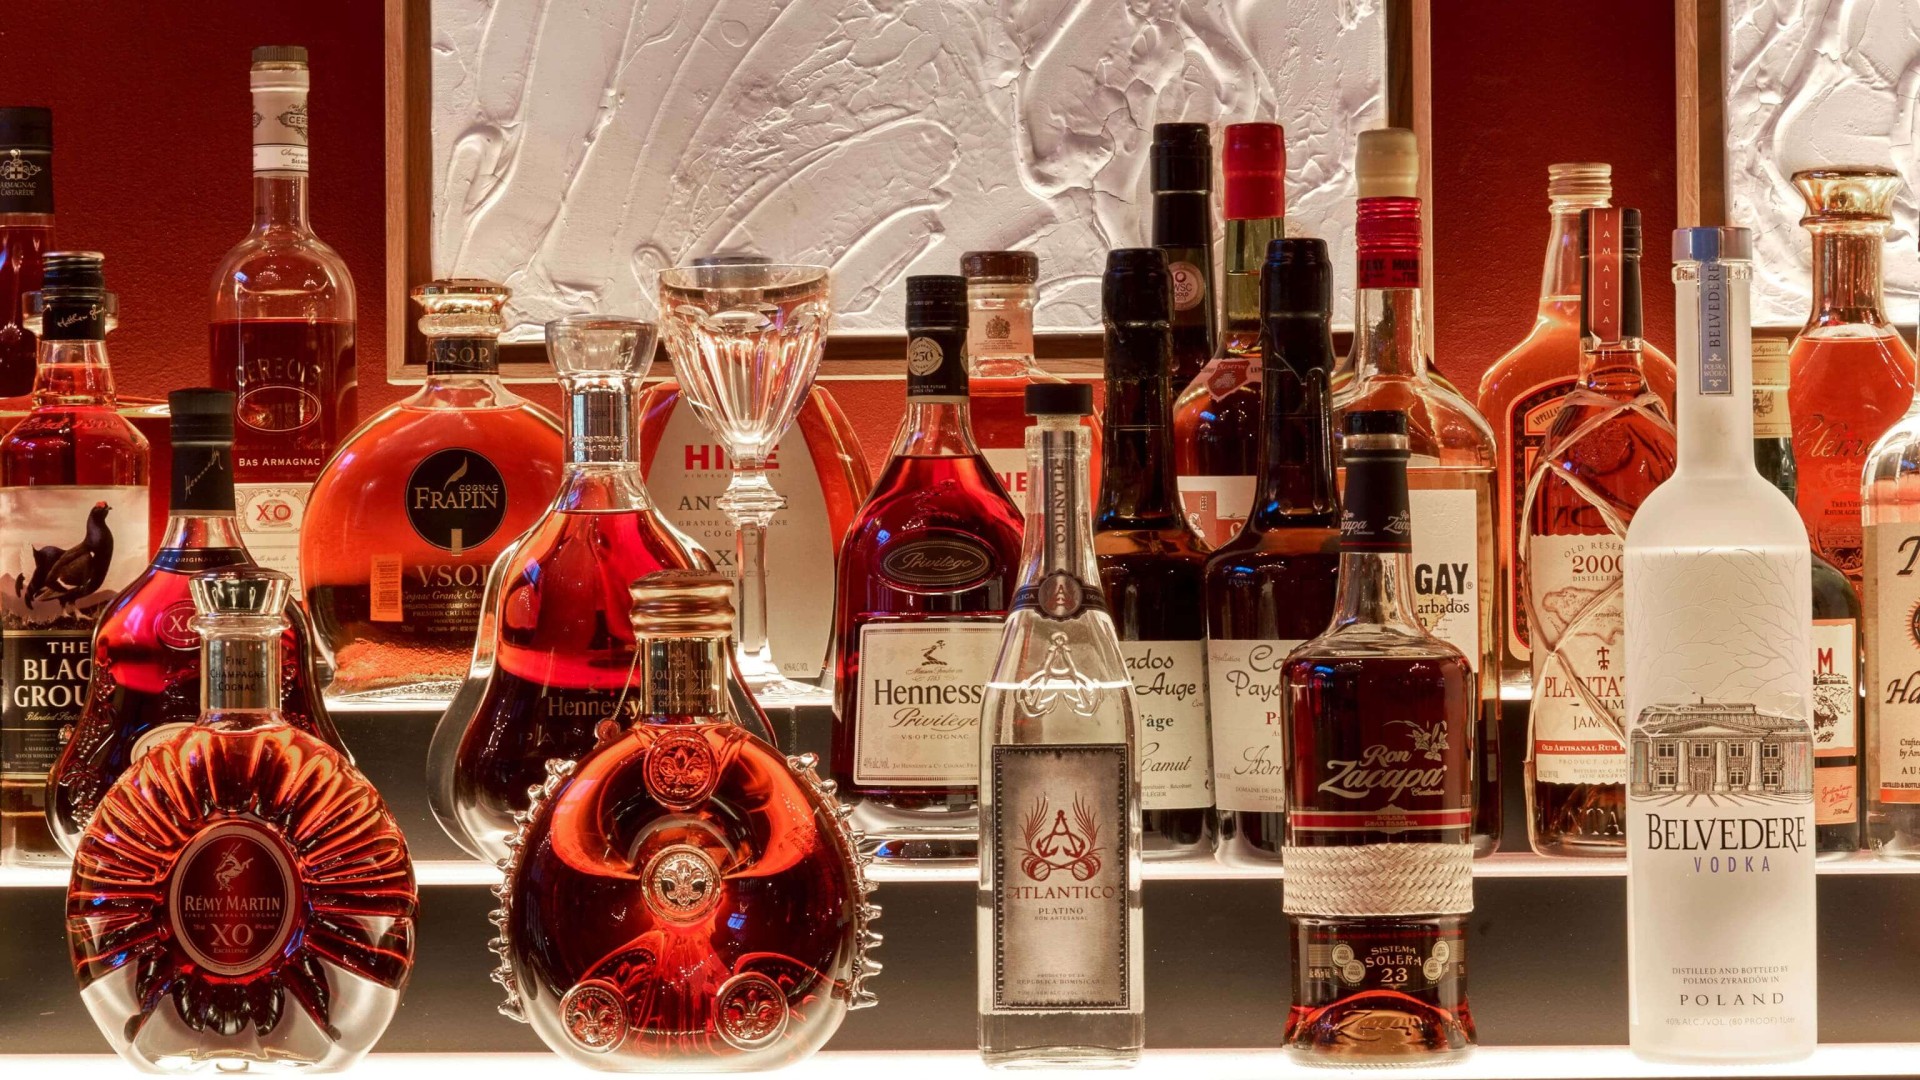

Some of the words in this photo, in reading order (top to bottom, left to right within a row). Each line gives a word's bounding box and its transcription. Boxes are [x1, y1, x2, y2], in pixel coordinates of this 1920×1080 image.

[1602, 212, 1611, 323] JAMAICA
[1708, 261, 1721, 347] BELVEDERE
[913, 351, 934, 362] 250
[685, 445, 780, 470] HIE
[995, 471, 1027, 492] NE
[414, 487, 500, 509] FRAPIN
[256, 504, 292, 521] XO
[1564, 544, 1585, 558] OLD
[1590, 542, 1624, 551] RESER
[1896, 535, 1920, 576] T
[1415, 563, 1469, 595] GAY
[464, 589, 481, 599] Cha
[1417, 598, 1470, 614] arbados
[47, 642, 90, 654] THE
[1125, 648, 1174, 670] ados
[1249, 644, 1284, 672] Ca
[23, 658, 92, 681] BLAC
[218, 682, 257, 692] COGNAC
[874, 679, 982, 706] Henness
[1884, 670, 1920, 705] Ha
[14, 685, 86, 708] GROU
[1554, 743, 1597, 751] ARTISANAL
[1598, 743, 1618, 751] RUM
[1900, 738, 1920, 749] Crafte
[1359, 744, 1413, 767] Ron
[1317, 759, 1445, 802] Zacapa
[1645, 813, 1807, 854] BELVEDERE
[1693, 855, 1770, 873] VODKA
[1006, 886, 1115, 899] ATLANTICO
[226, 895, 280, 911] MARTIN
[1038, 907, 1084, 915] PLATINO
[210, 923, 254, 947] XO
[1371, 945, 1417, 956] SISTEMA
[1365, 955, 1422, 968] SOLERA
[1672, 967, 1717, 975] DISTILLED
[1719, 967, 1739, 975] AND
[1741, 966, 1779, 974] BOTTLED
[1380, 968, 1409, 983] 23
[1680, 992, 1784, 1006] POLAND
